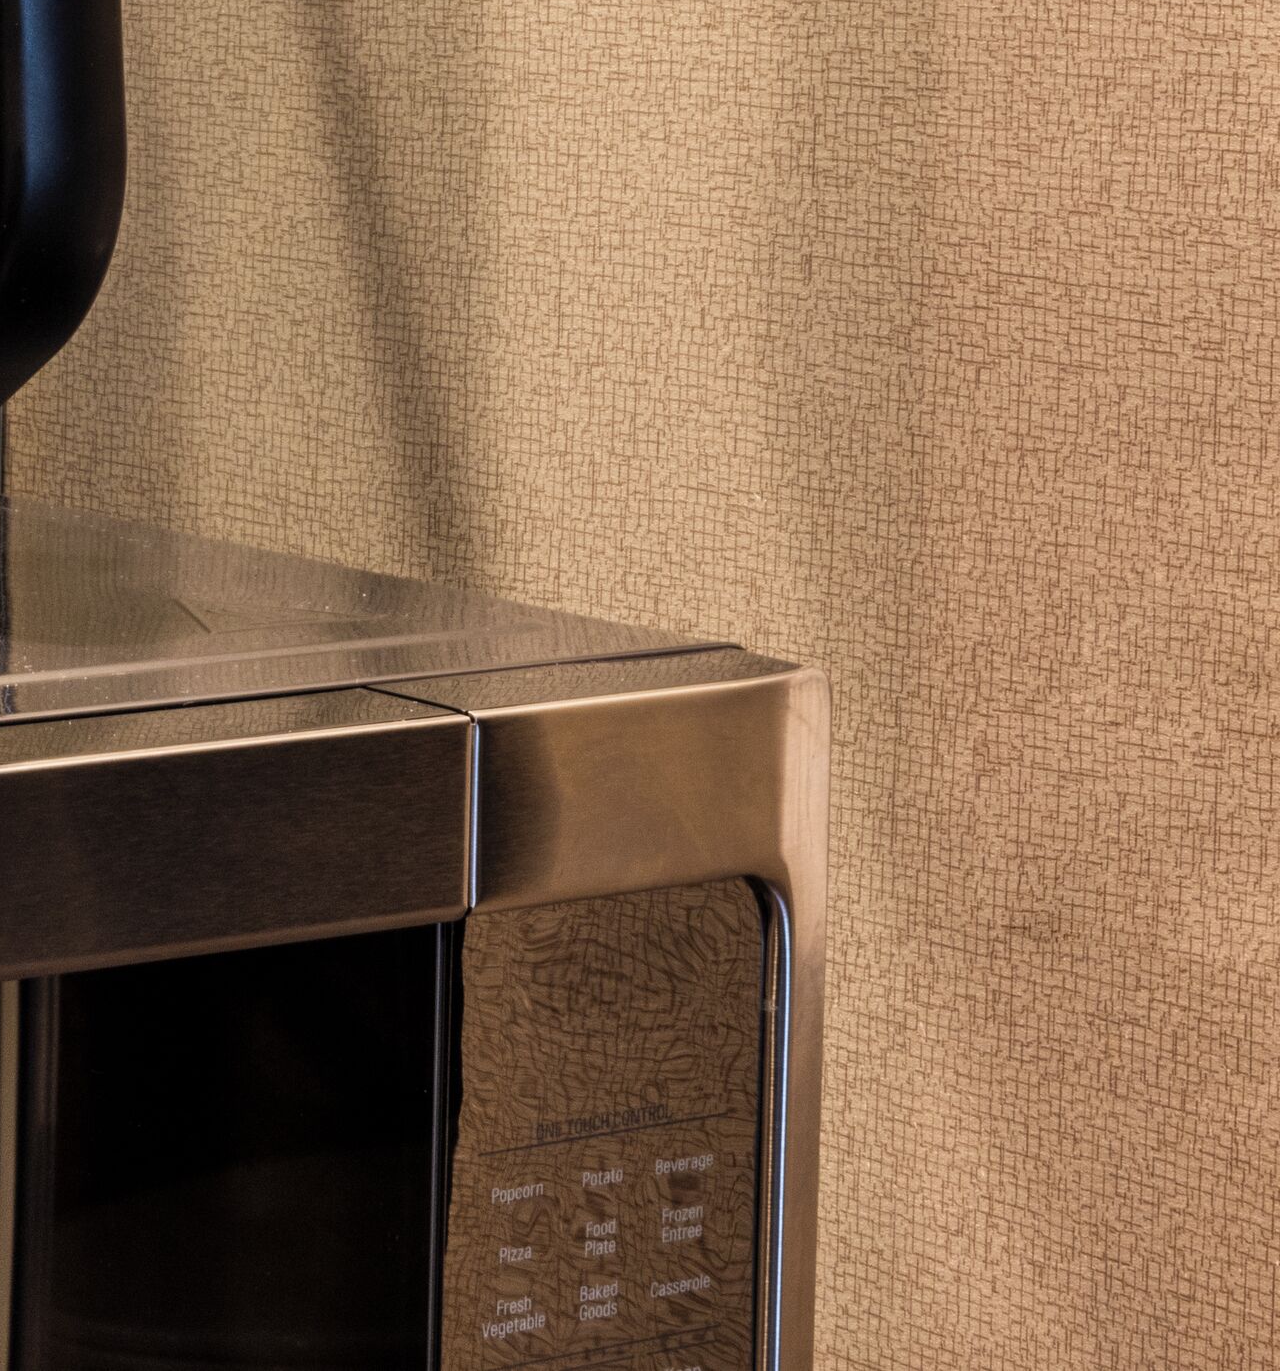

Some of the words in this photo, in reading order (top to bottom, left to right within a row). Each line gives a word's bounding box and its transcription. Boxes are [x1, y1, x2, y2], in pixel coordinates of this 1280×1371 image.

[536, 1119, 562, 1140] ONE
[567, 1111, 611, 1135] TOUCH
[614, 1105, 672, 1128] CONTROL
[655, 1152, 714, 1176] Beverage
[582, 1168, 624, 1188] Potato
[491, 1182, 544, 1206] Popcorn
[662, 1205, 704, 1223] Frozen
[585, 1219, 616, 1237] Food
[662, 1223, 703, 1244] Entree
[499, 1246, 532, 1264] Pizza
[584, 1238, 616, 1257] Plate
[579, 1282, 619, 1302] Baked
[650, 1275, 711, 1299] Casserole
[496, 1297, 532, 1316] Fresh
[579, 1299, 618, 1322] Goods
[481, 1312, 546, 1340] Vegetable
